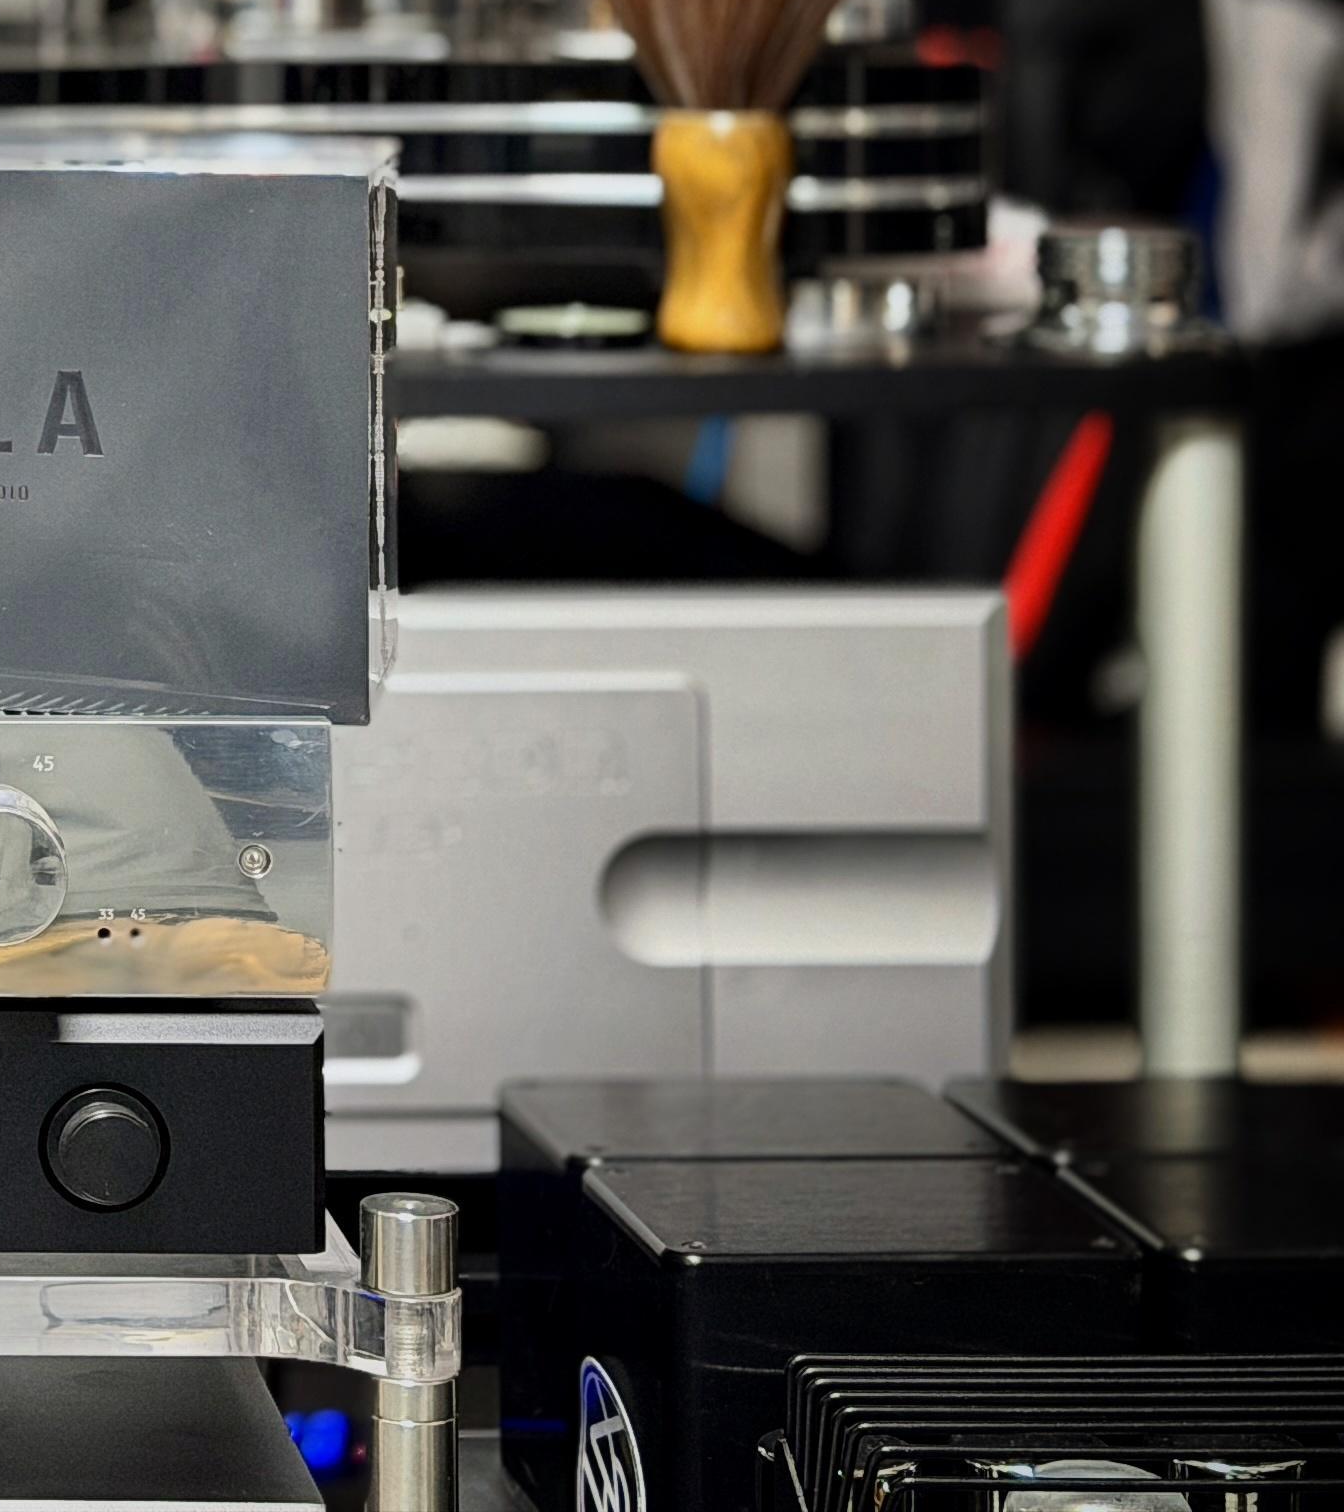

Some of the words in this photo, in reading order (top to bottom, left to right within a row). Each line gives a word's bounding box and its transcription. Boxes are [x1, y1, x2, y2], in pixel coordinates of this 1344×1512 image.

[32, 755, 55, 772] 45
[98, 908, 114, 921] 33
[130, 908, 146, 921] 45
